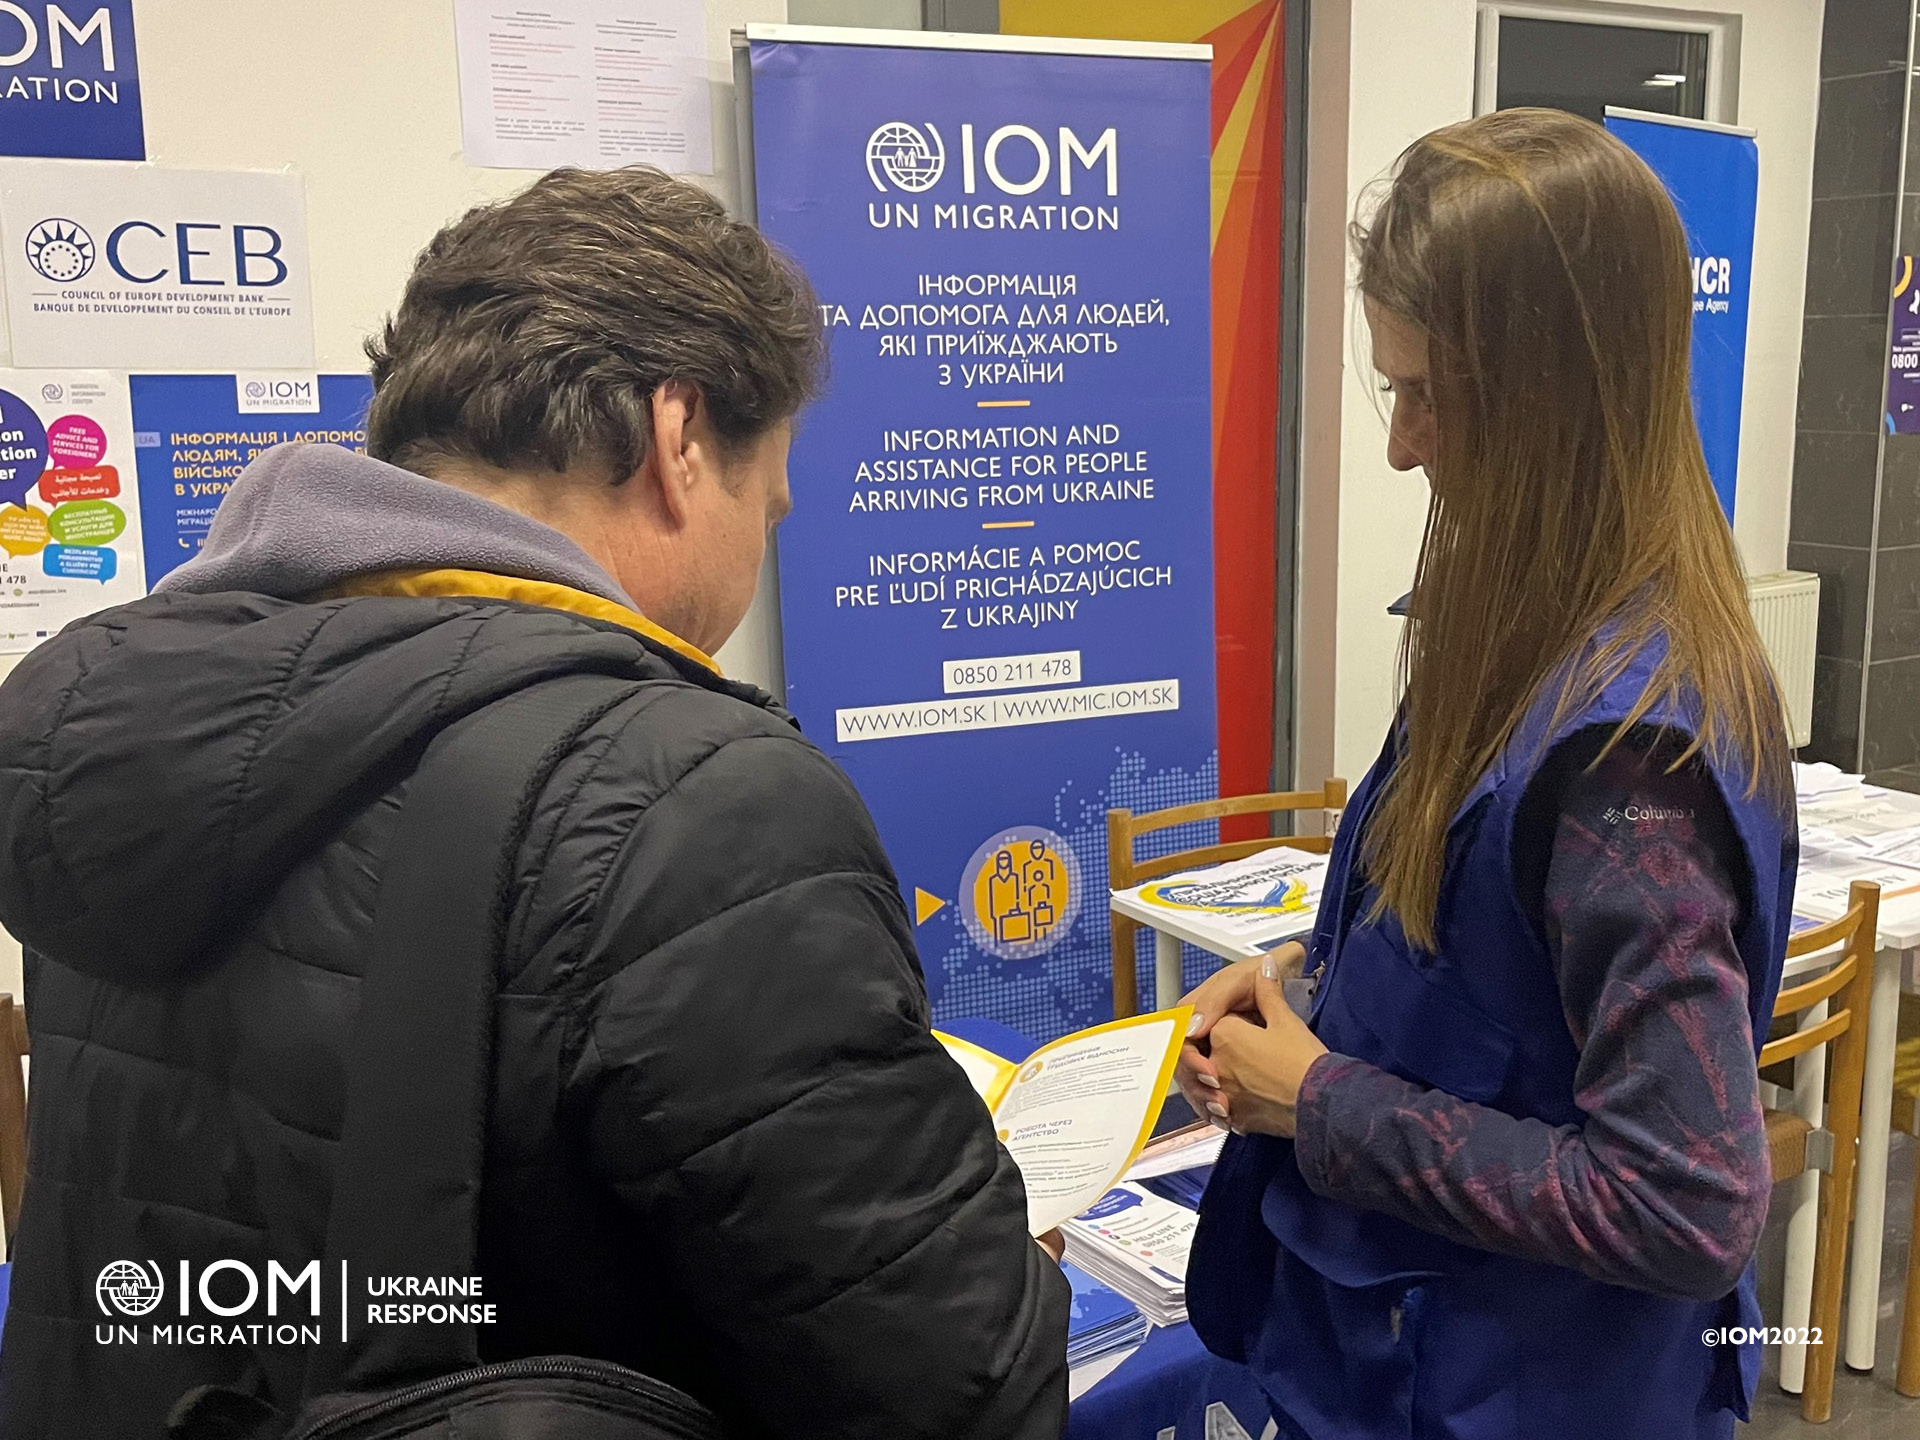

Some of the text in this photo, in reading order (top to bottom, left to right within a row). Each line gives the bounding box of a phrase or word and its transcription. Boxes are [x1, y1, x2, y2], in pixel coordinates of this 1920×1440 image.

[0, 76, 118, 103] ATION
[962, 124, 1117, 195] IOM
[869, 203, 1119, 230] UN MIGRATION
[106, 221, 288, 287] CEB
[62, 290, 264, 303] COUNCIL OF EUROPE DEVELOPMENT BANK
[919, 275, 1076, 299] ІНФОРМАЦІЯ
[33, 303, 292, 316] BANQUE DE DEVELOPPEMENT DU CONSEIL DE L'EUROPE
[818, 299, 1170, 330] ТА ДОПОМОГА ДЛЯ ЛЮДЕЙ,
[878, 331, 1118, 358] ЯКІ ПРИЇЖДЖАЮТЬ
[1891, 353, 1919, 369] 0800
[938, 359, 1064, 388] З УКРАЇНИ
[269, 381, 311, 398] IOM
[0, 430, 24, 442] on
[55, 433, 98, 444] ADVICE AND
[69, 427, 86, 435] FREE
[171, 432, 277, 446] ІНФОРМАЦІЯ
[293, 431, 367, 444] ДОПОМО
[885, 424, 1120, 452] INFORMATION AND
[53, 440, 84, 450] SERVICES
[172, 449, 242, 464] ЛЮДЯМ,
[173, 464, 244, 479] ВІЙСЬКО
[855, 451, 1147, 483] ASSISTANCE FOR PEOPLE
[174, 482, 232, 498] В УКРА
[849, 479, 1154, 512] ARRIVING FROM UKRAINE
[177, 508, 217, 517] МІЖНАРО
[869, 540, 1141, 576] INFORMÁCIE A POMOC
[6, 575, 27, 584] 478
[835, 565, 1171, 608] PRE ĽUDÍ PRICHÁDZAJÚCICH
[941, 600, 1078, 629] Z UKRAJINY
[953, 659, 1072, 685] 0850 211 478
[842, 686, 1173, 733] WWW.IOM.SK WWW.MIC.IOM.SK
[1011, 1129, 1059, 1141] АГЕНТСТВО
[1015, 1119, 1072, 1135] РОБОТА ЧЕРЕЗ
[1132, 1224, 1175, 1243] HELPLINE
